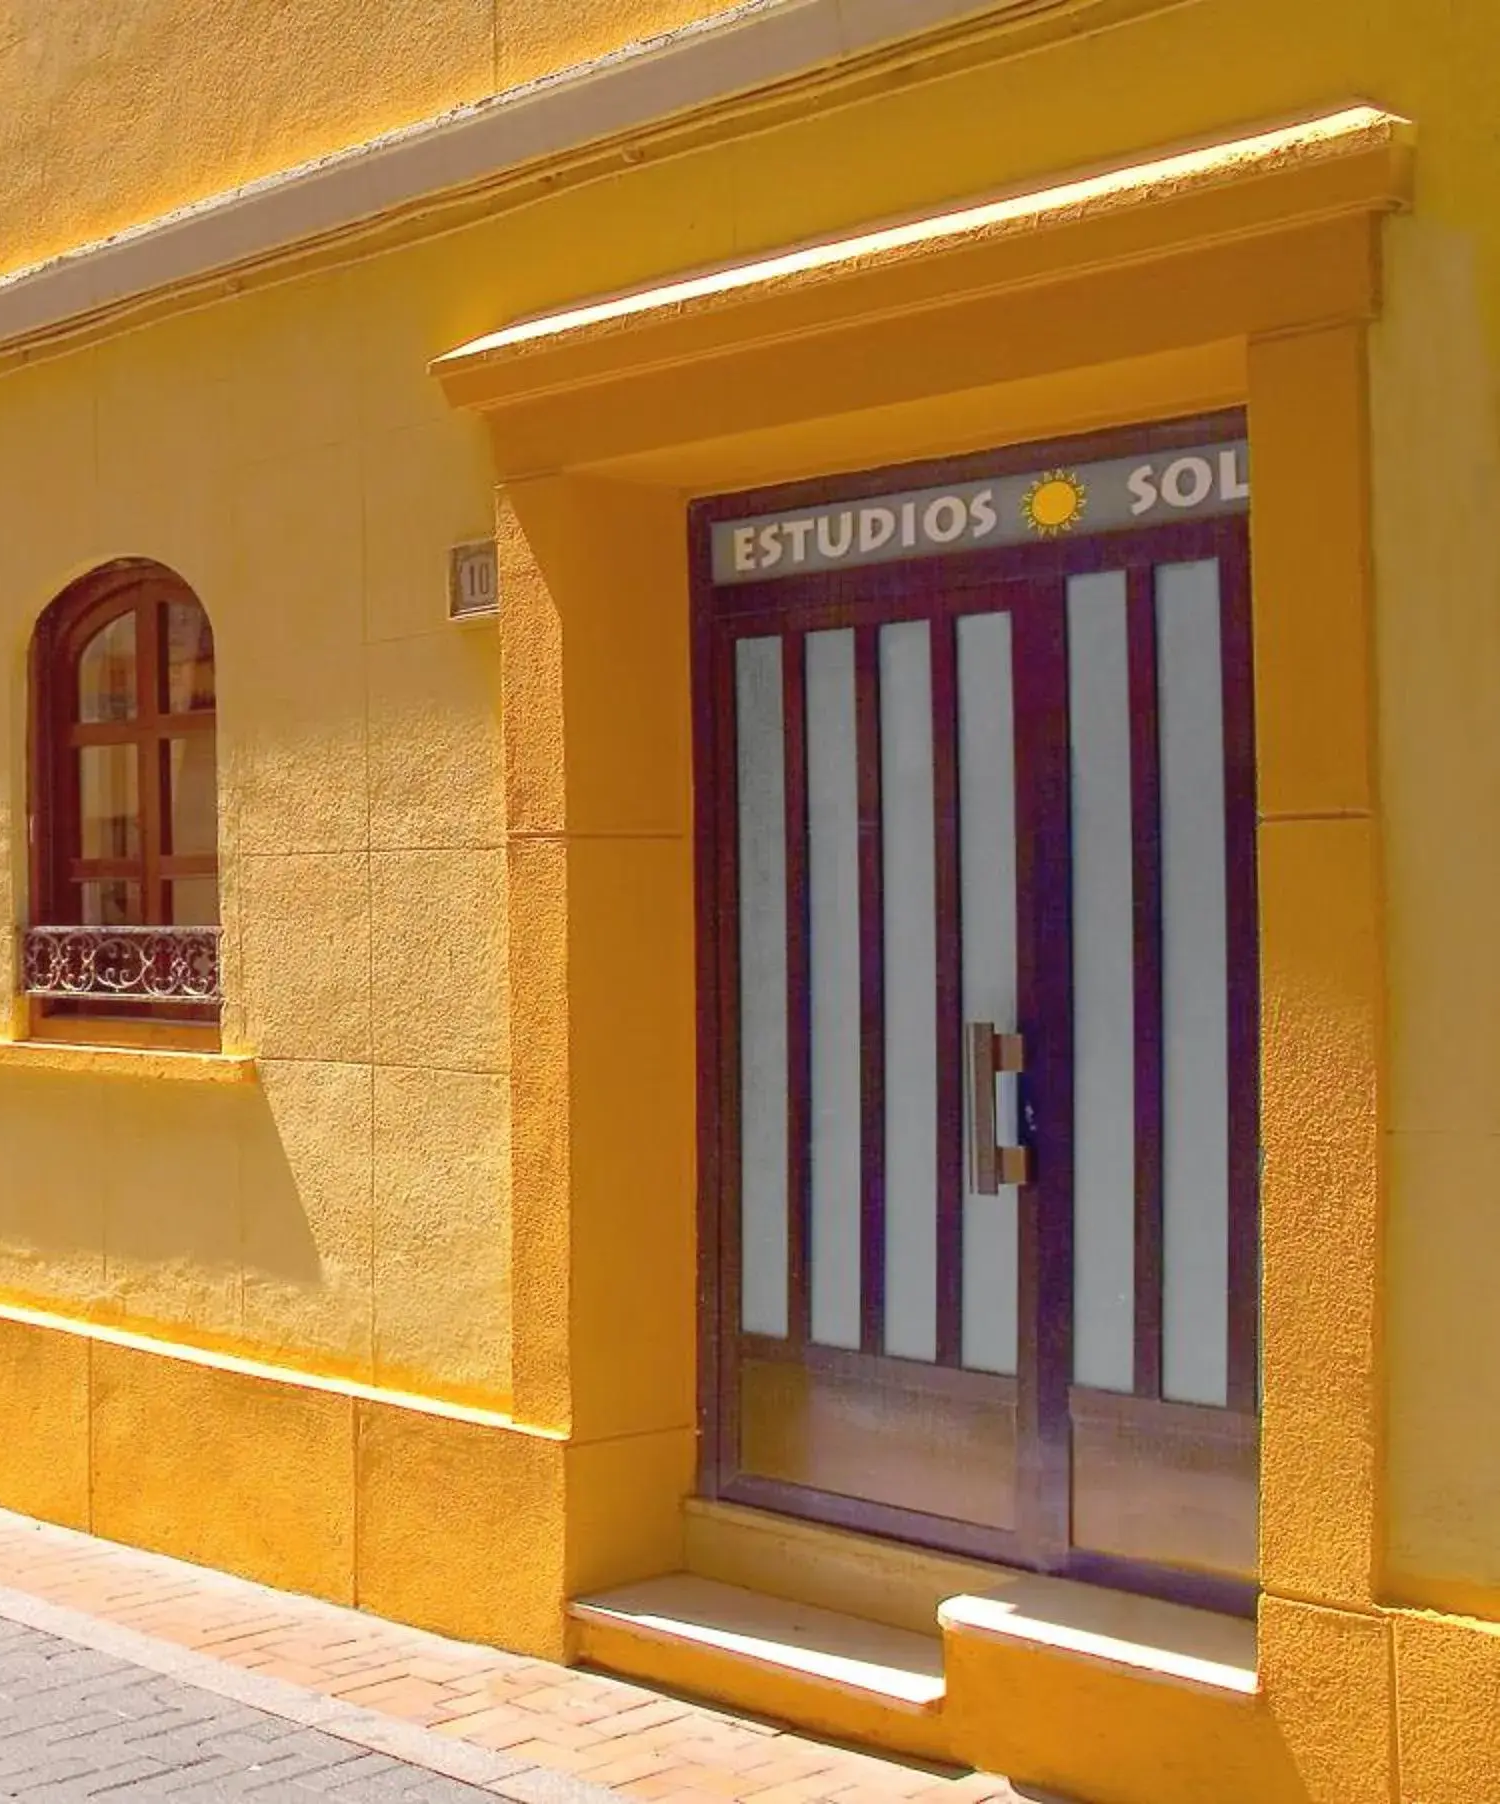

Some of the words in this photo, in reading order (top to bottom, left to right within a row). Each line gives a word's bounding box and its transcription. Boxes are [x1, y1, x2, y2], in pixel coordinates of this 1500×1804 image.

[735, 488, 997, 572] ESTUDIOS
[1126, 449, 1248, 516] SOL
[468, 562, 490, 596] 10
